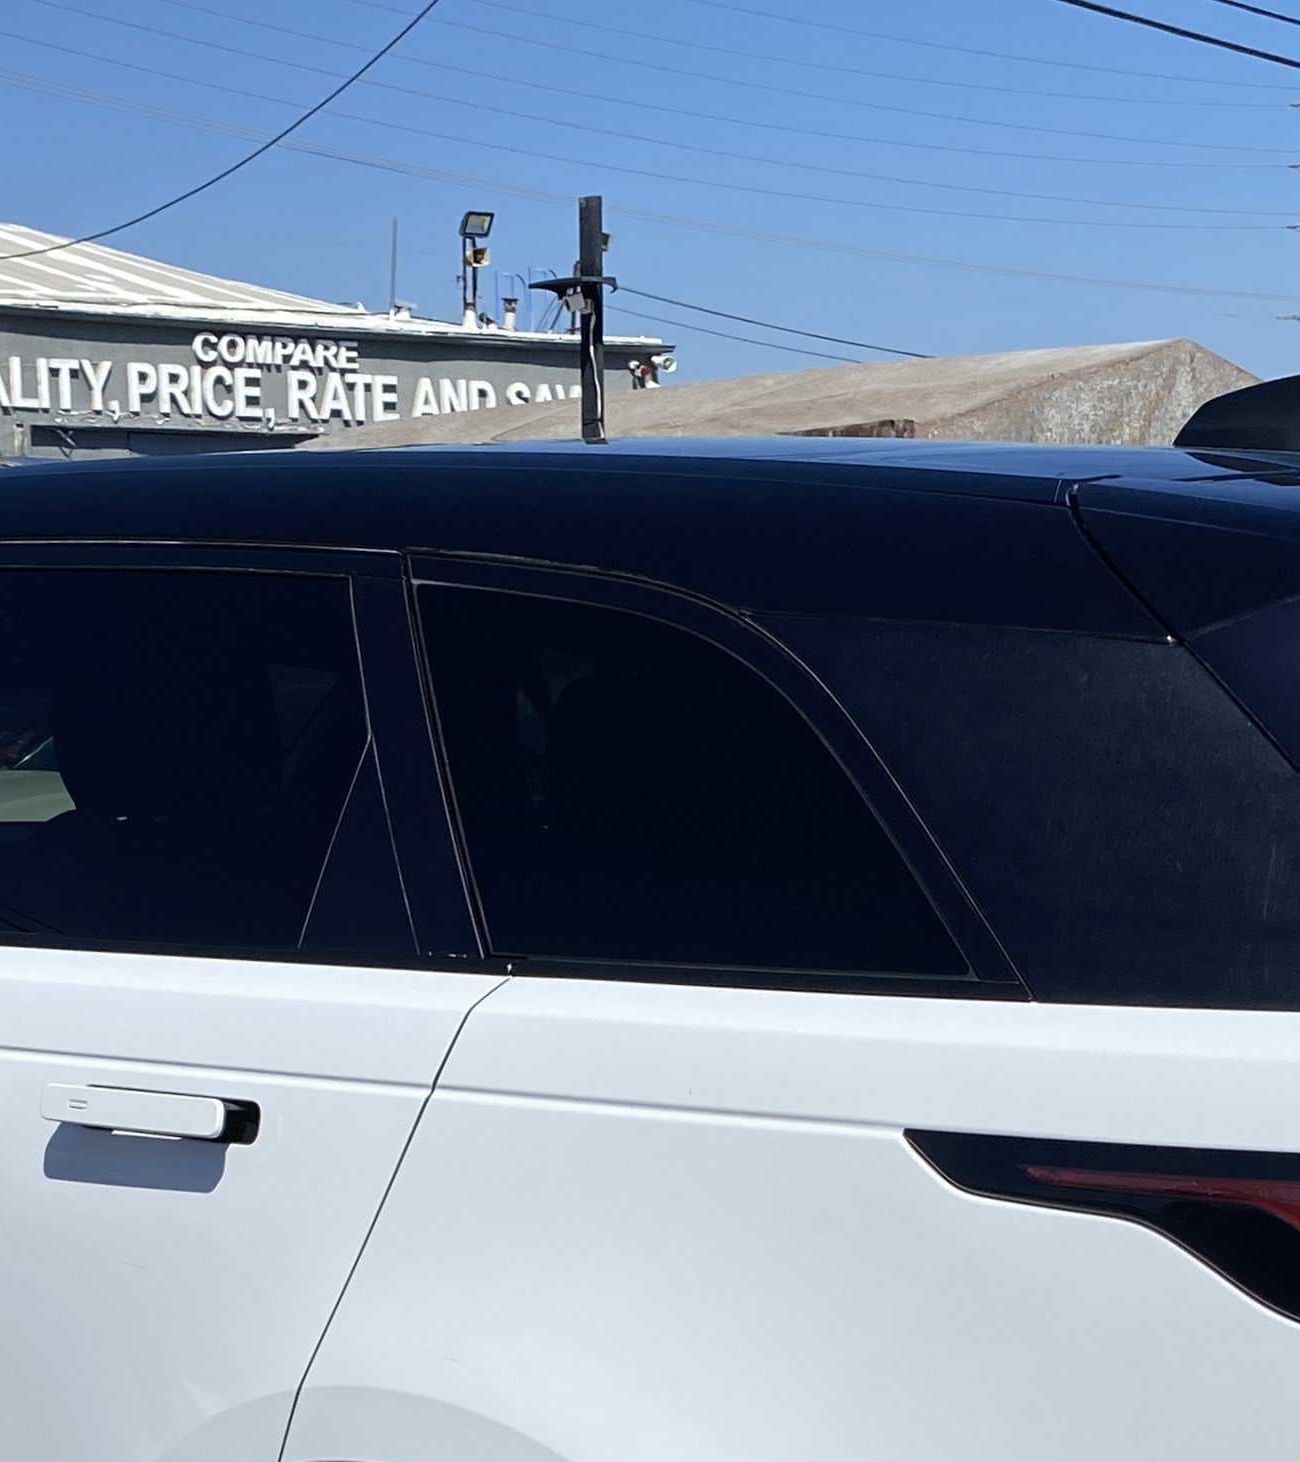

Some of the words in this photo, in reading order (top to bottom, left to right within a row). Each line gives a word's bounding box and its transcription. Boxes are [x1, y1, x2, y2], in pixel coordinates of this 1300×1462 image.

[192, 331, 360, 369] COMPARE
[126, 361, 276, 428] PRICE,
[287, 369, 400, 423] RATE
[411, 376, 497, 418] AND
